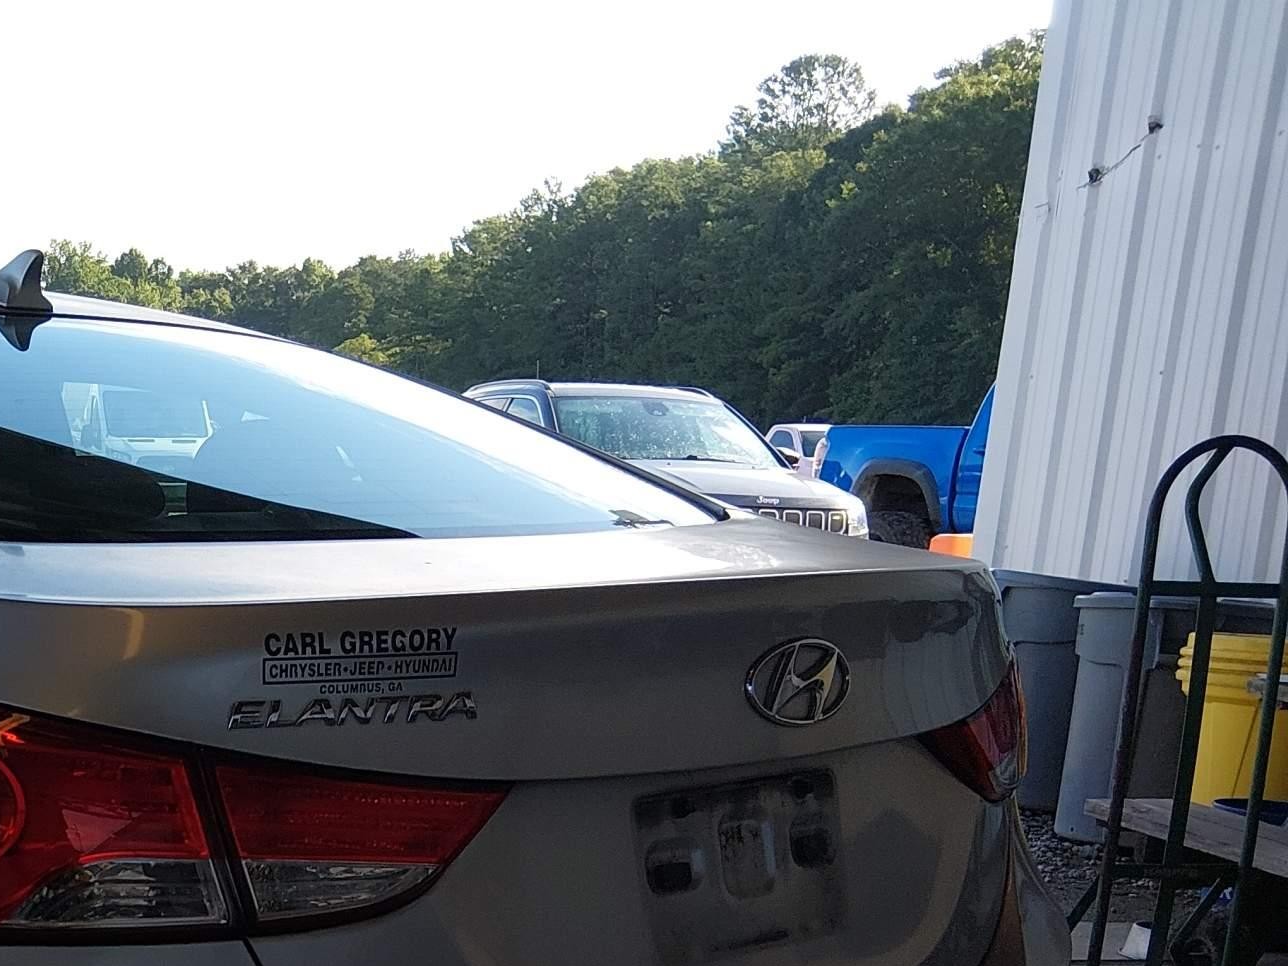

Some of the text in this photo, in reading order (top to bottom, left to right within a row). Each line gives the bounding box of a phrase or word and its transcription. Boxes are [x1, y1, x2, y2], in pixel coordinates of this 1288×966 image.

[264, 627, 457, 656] CARL GREGORY
[319, 681, 403, 696] COLUMBUS, GA
[227, 691, 478, 731] ELANTRA
